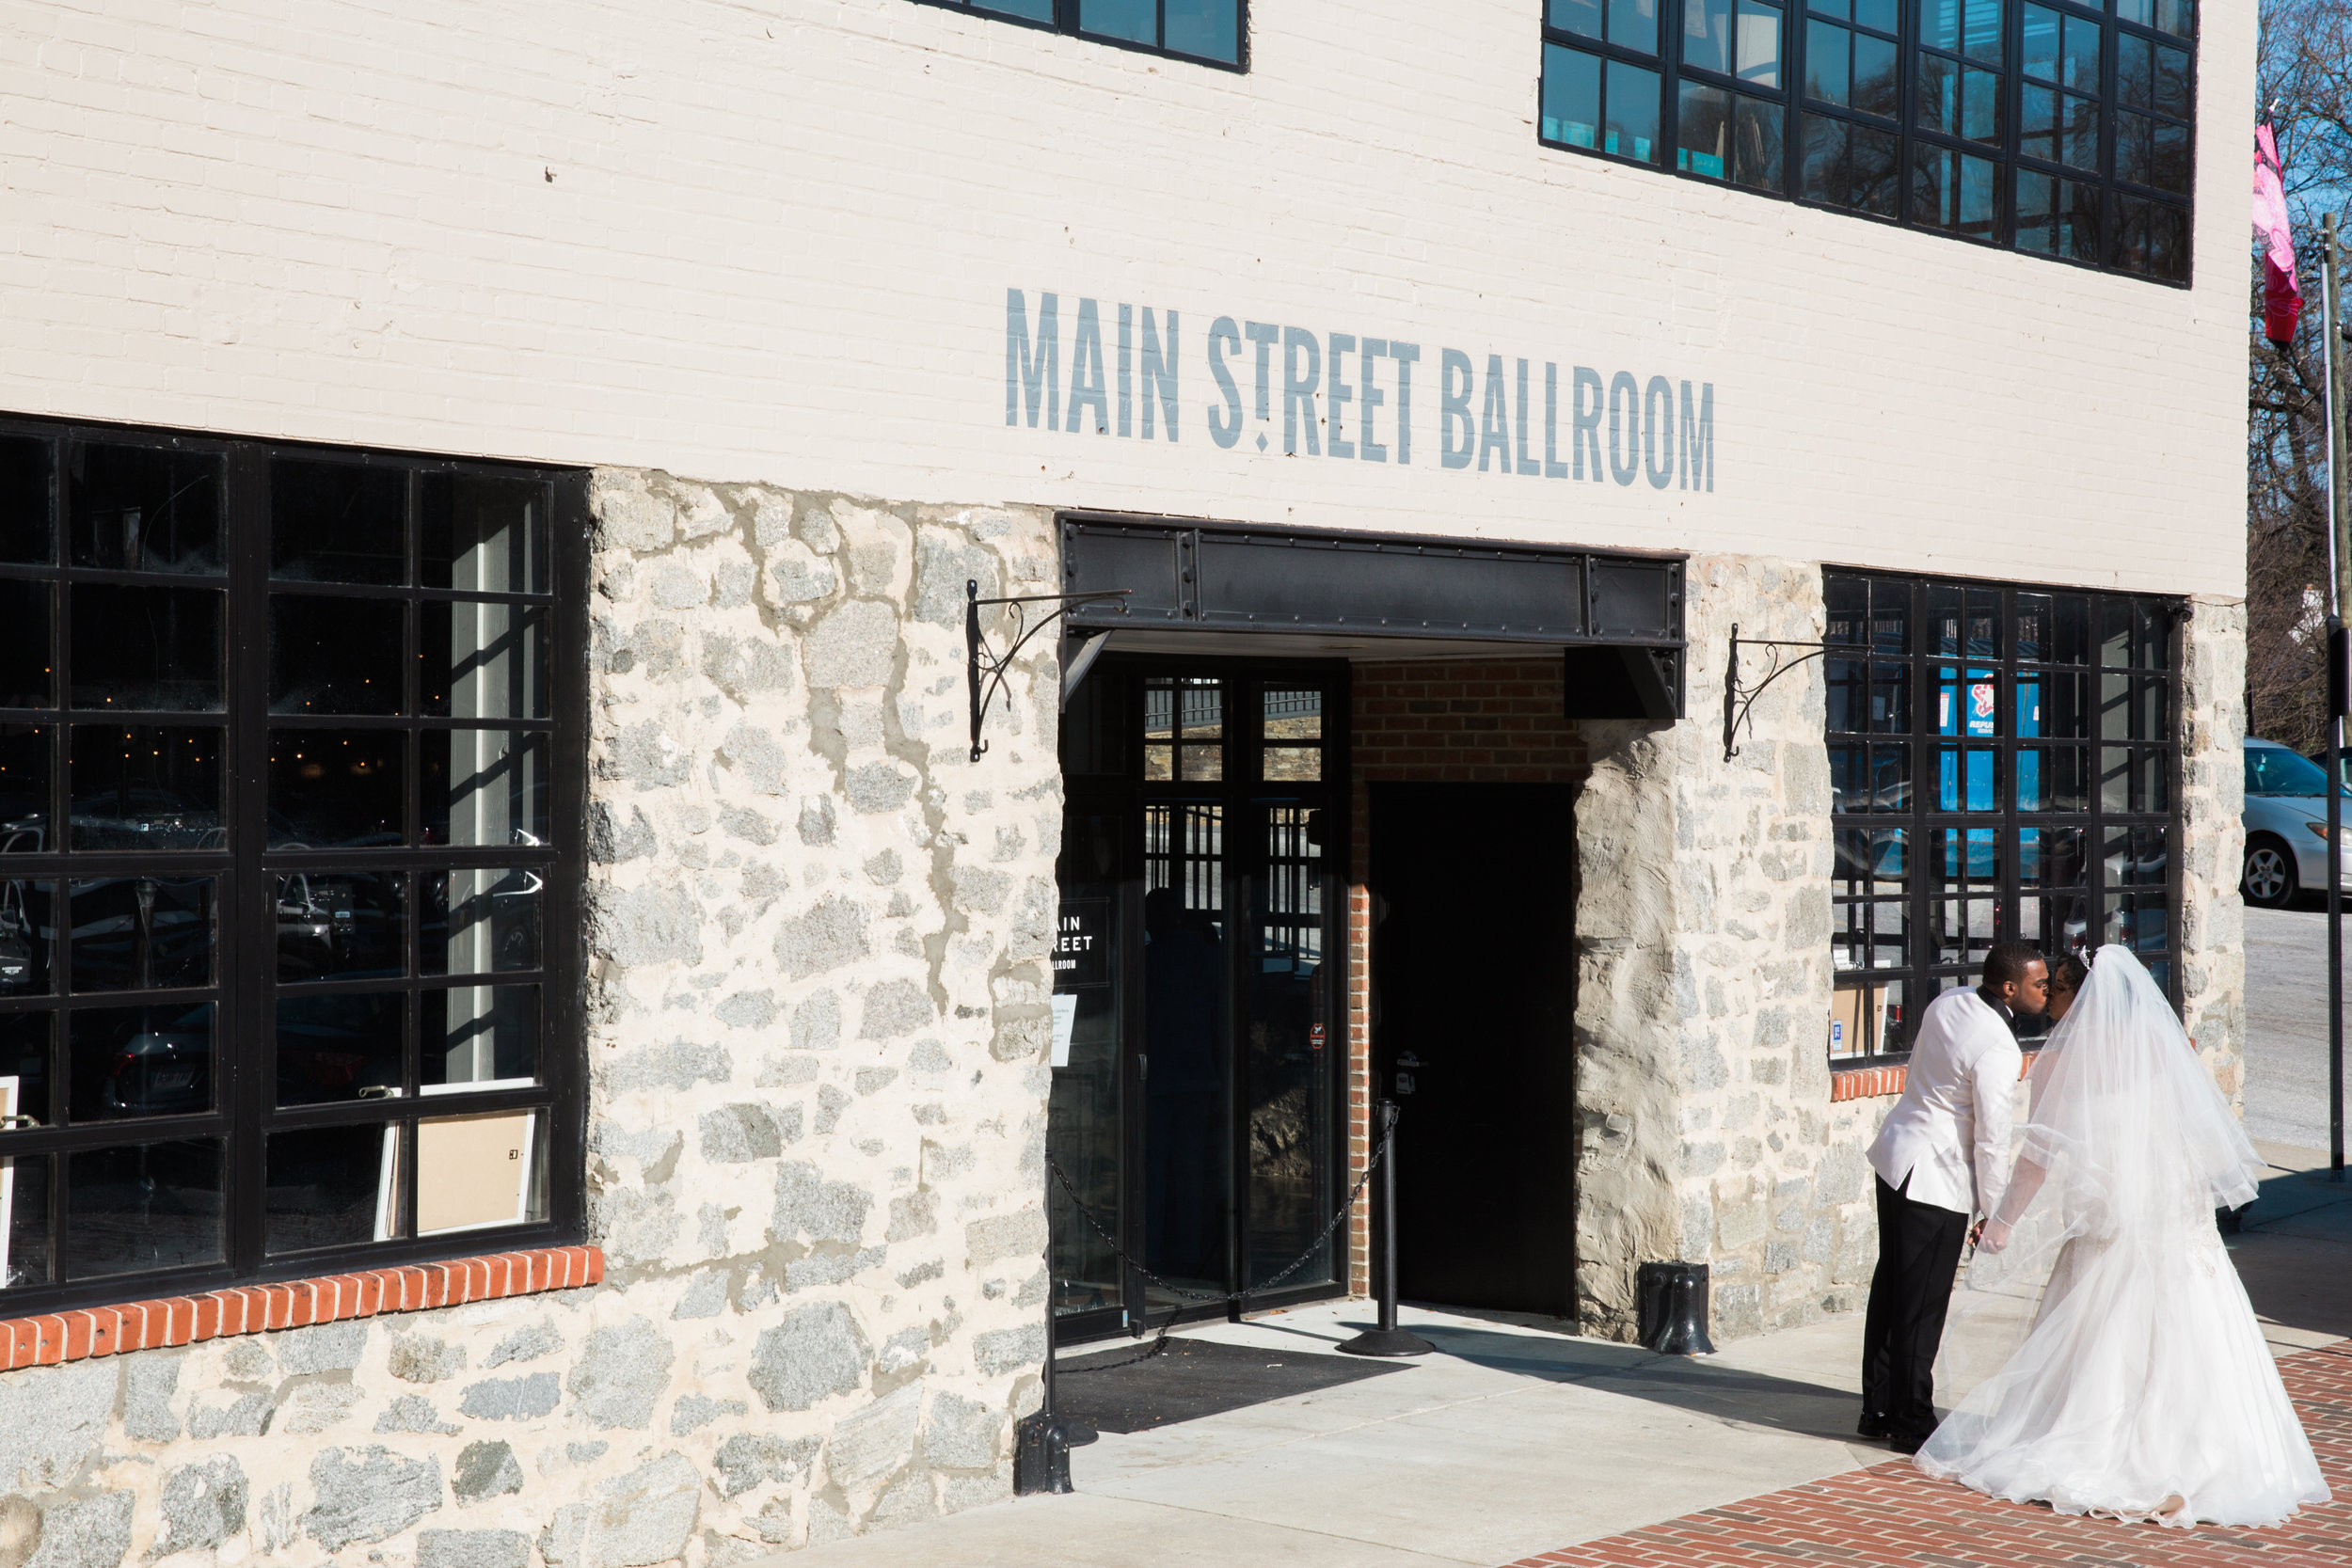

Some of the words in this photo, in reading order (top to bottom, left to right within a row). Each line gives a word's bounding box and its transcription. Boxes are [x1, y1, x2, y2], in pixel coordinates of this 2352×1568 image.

[1006, 288, 1179, 443] MAIN
[1207, 316, 1420, 465] STREET
[1440, 347, 1714, 493] BALLROOM
